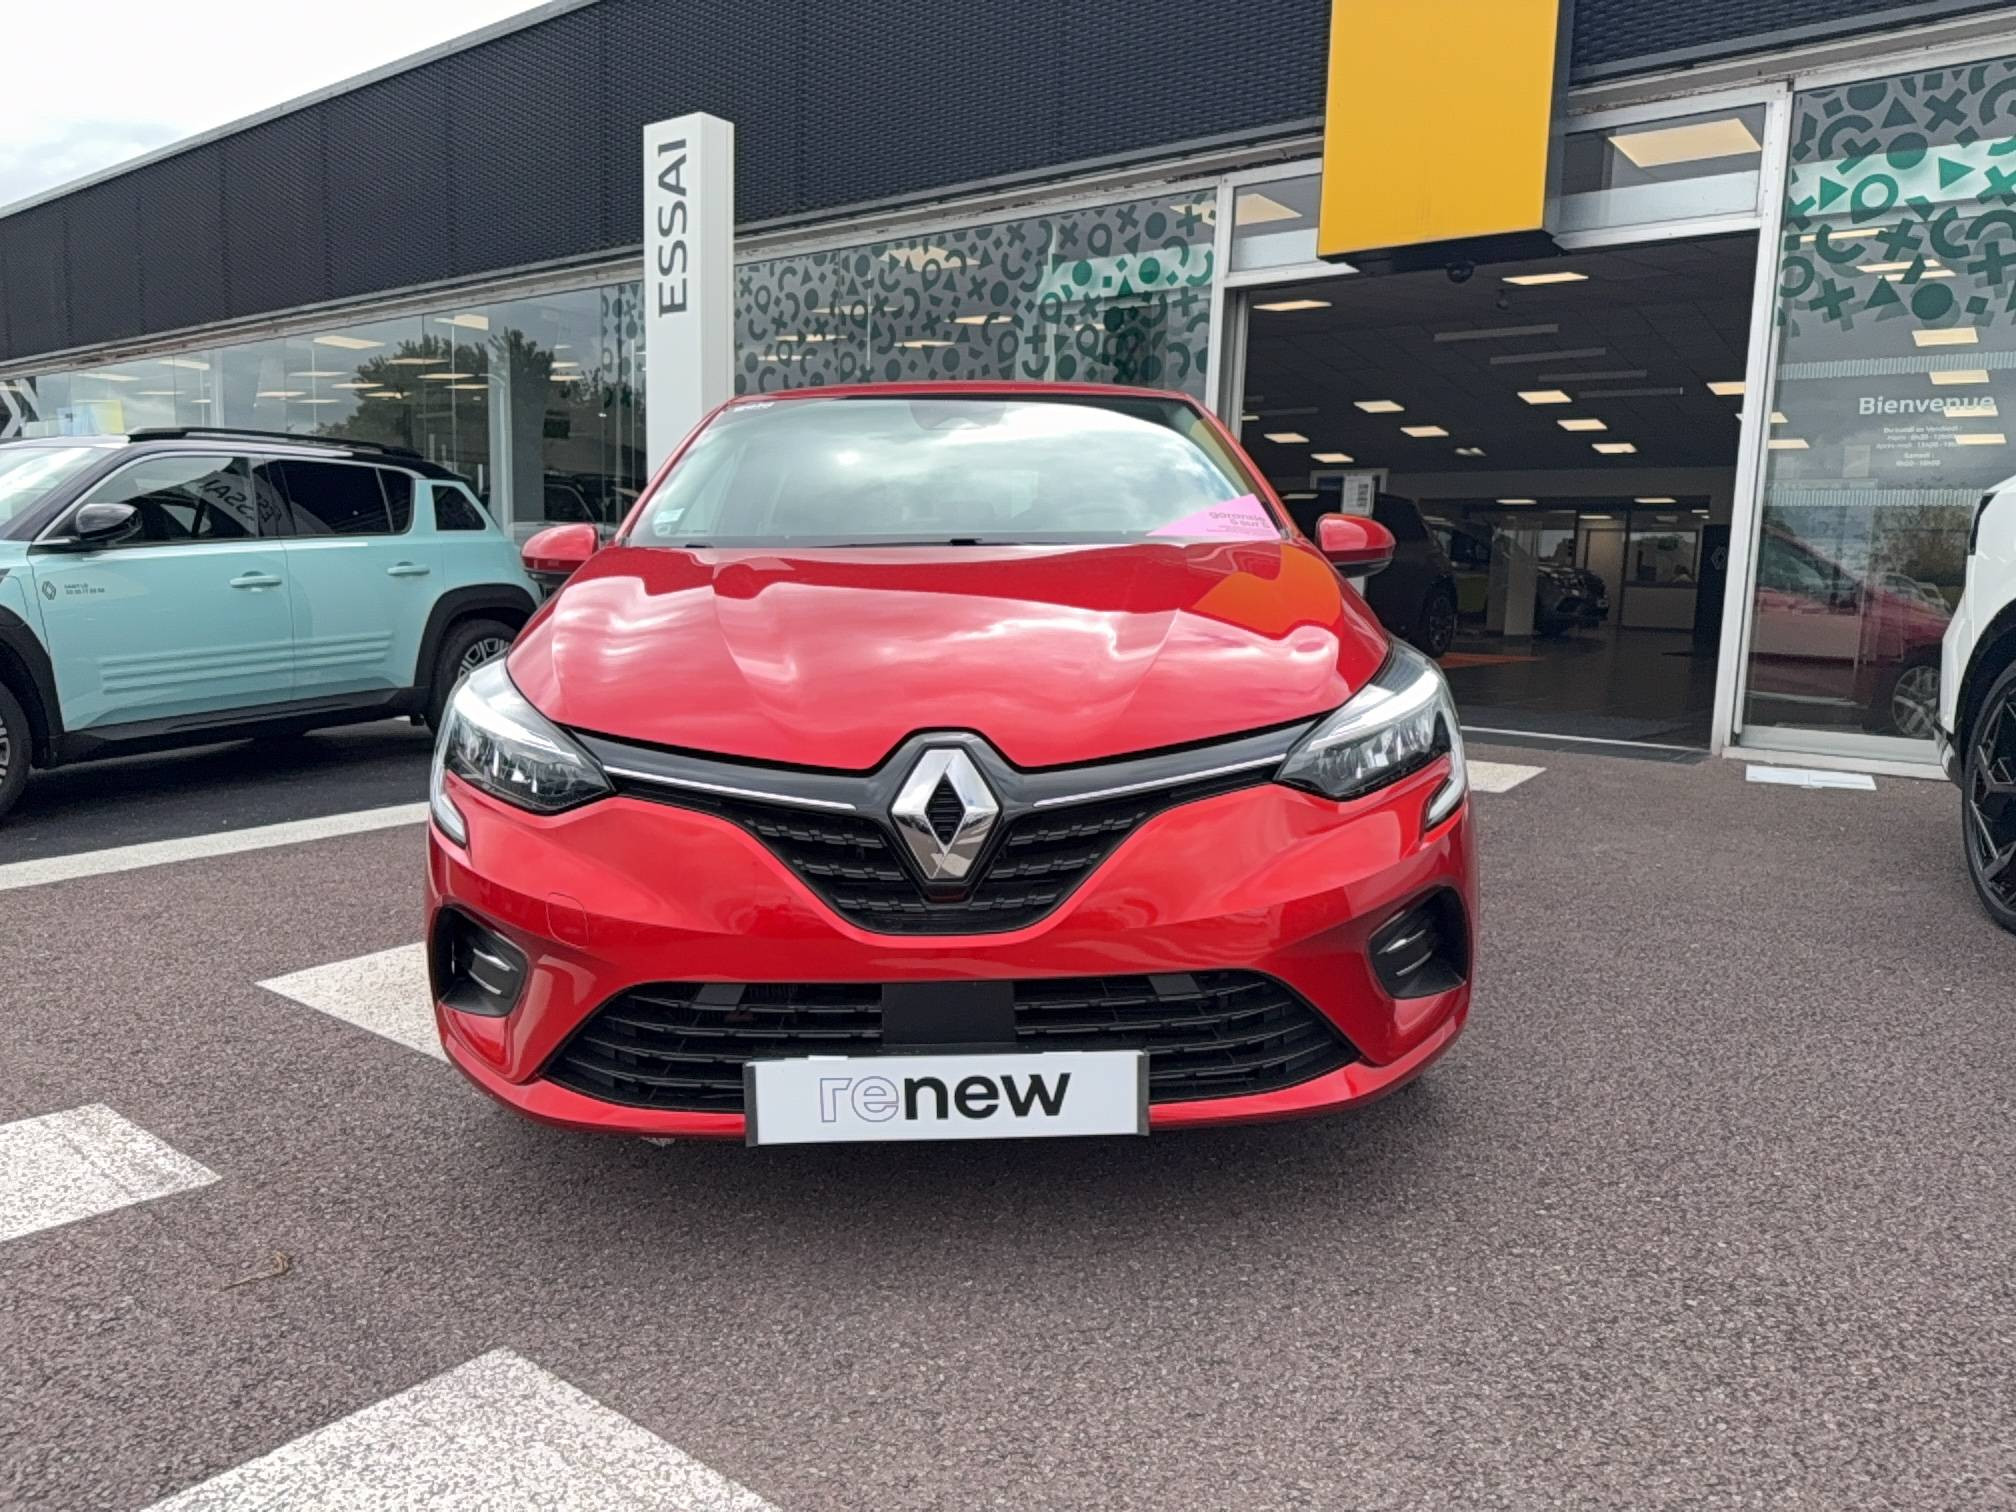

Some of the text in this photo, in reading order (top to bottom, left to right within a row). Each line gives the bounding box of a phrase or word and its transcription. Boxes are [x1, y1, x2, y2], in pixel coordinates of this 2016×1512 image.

[658, 138, 688, 318] ESSAI
[1859, 396, 1996, 415] Bienvenue
[819, 1072, 1072, 1123] renew
